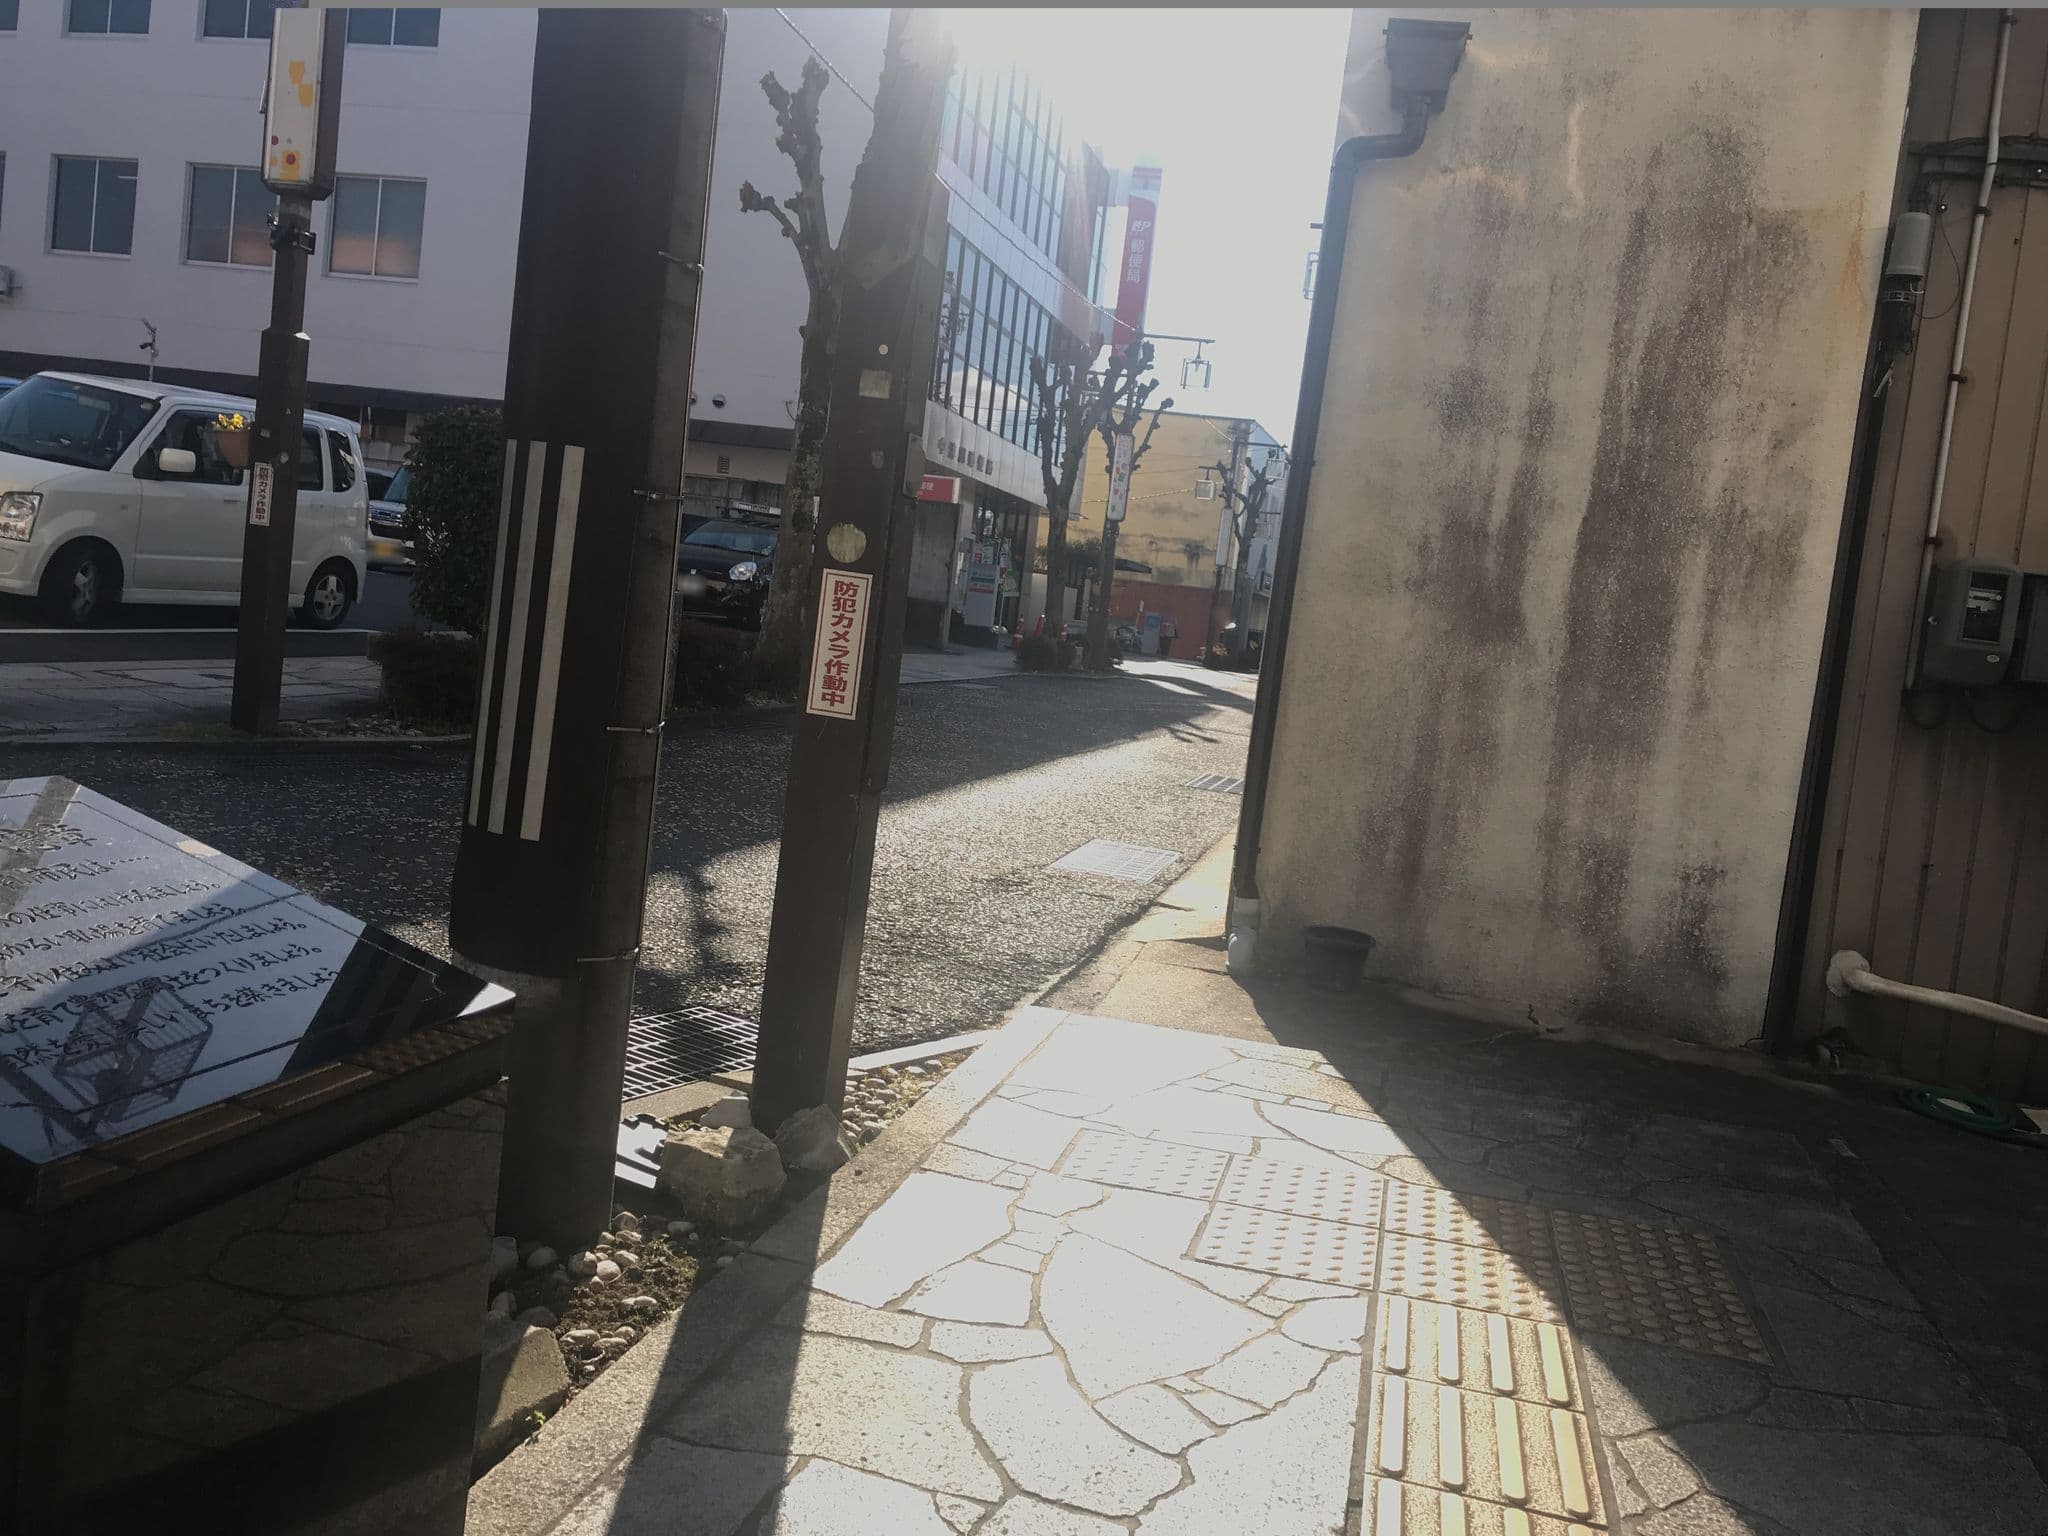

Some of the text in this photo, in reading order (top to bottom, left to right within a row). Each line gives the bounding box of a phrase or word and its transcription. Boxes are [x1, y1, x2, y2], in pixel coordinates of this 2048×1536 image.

[1126, 238, 1145, 283] 郵便局
[821, 579, 860, 707] 防犯カメラ作動中
